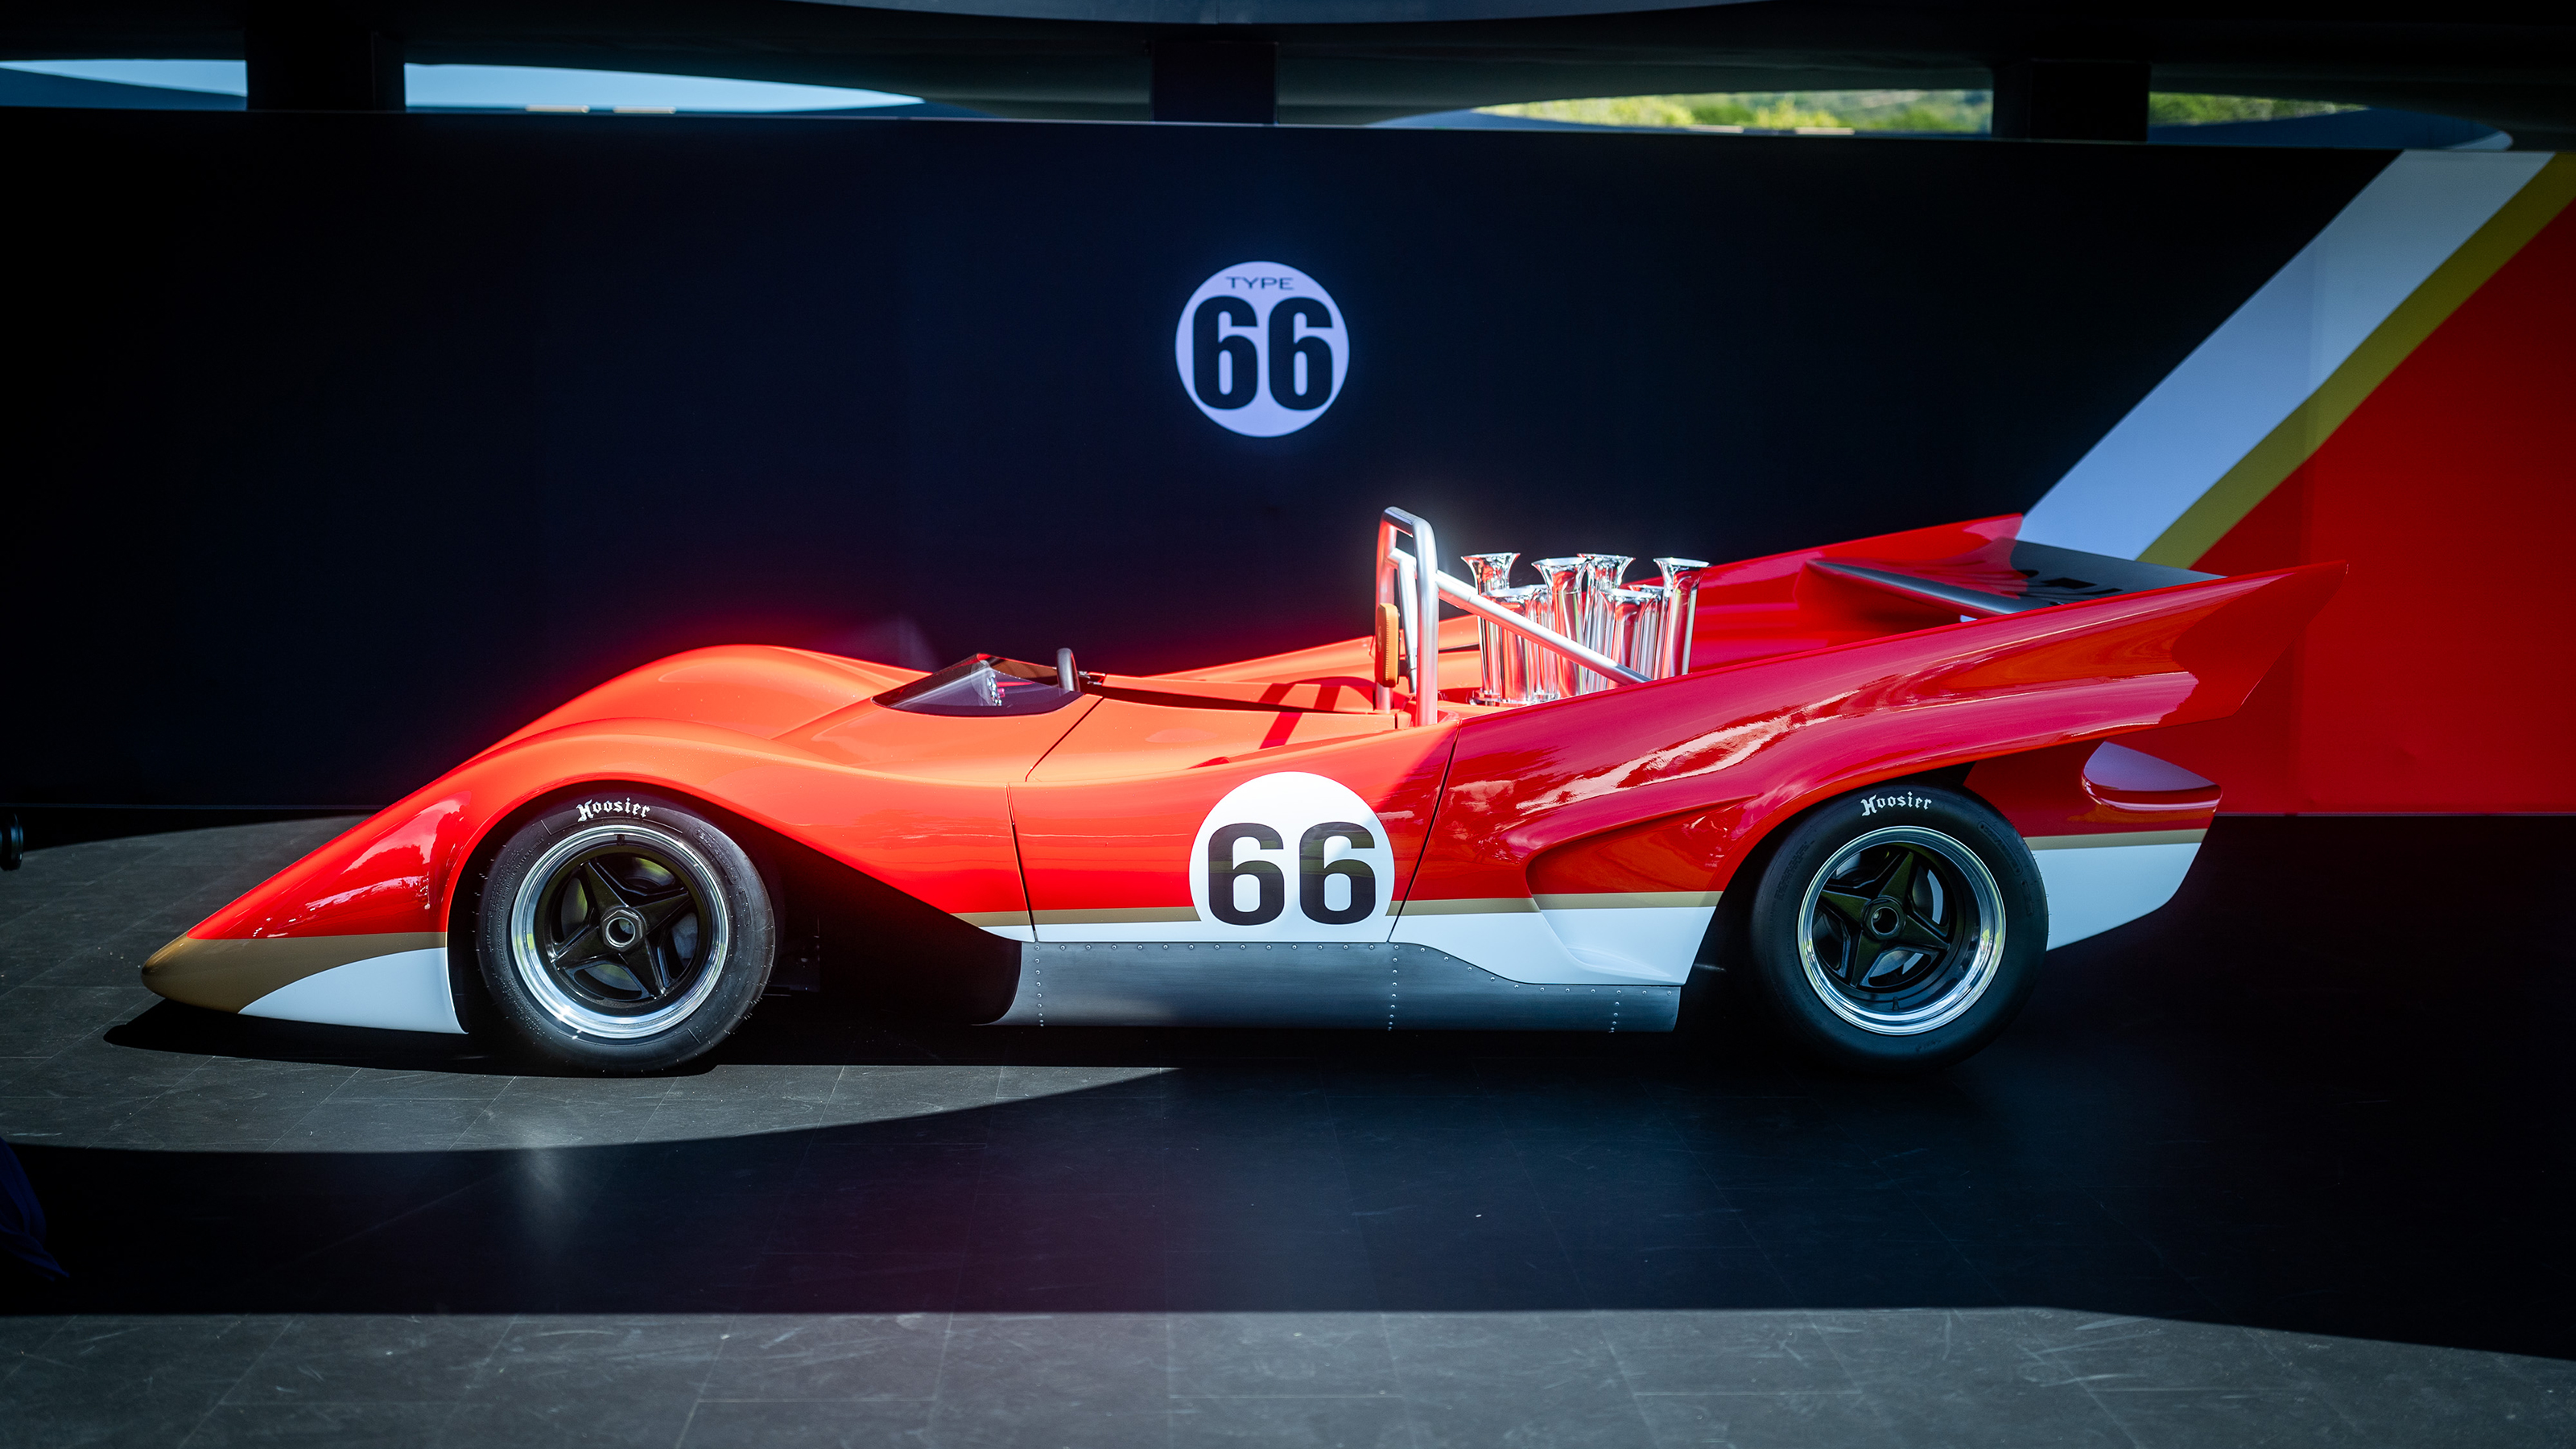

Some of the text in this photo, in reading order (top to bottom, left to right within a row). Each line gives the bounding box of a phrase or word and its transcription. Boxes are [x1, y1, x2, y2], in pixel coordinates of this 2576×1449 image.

[1225, 276, 1294, 291] TYPE
[1192, 295, 1333, 411] 66
[576, 797, 650, 822] Hoosier
[1860, 791, 1932, 816] Hoosier
[1208, 821, 1376, 926] 66
